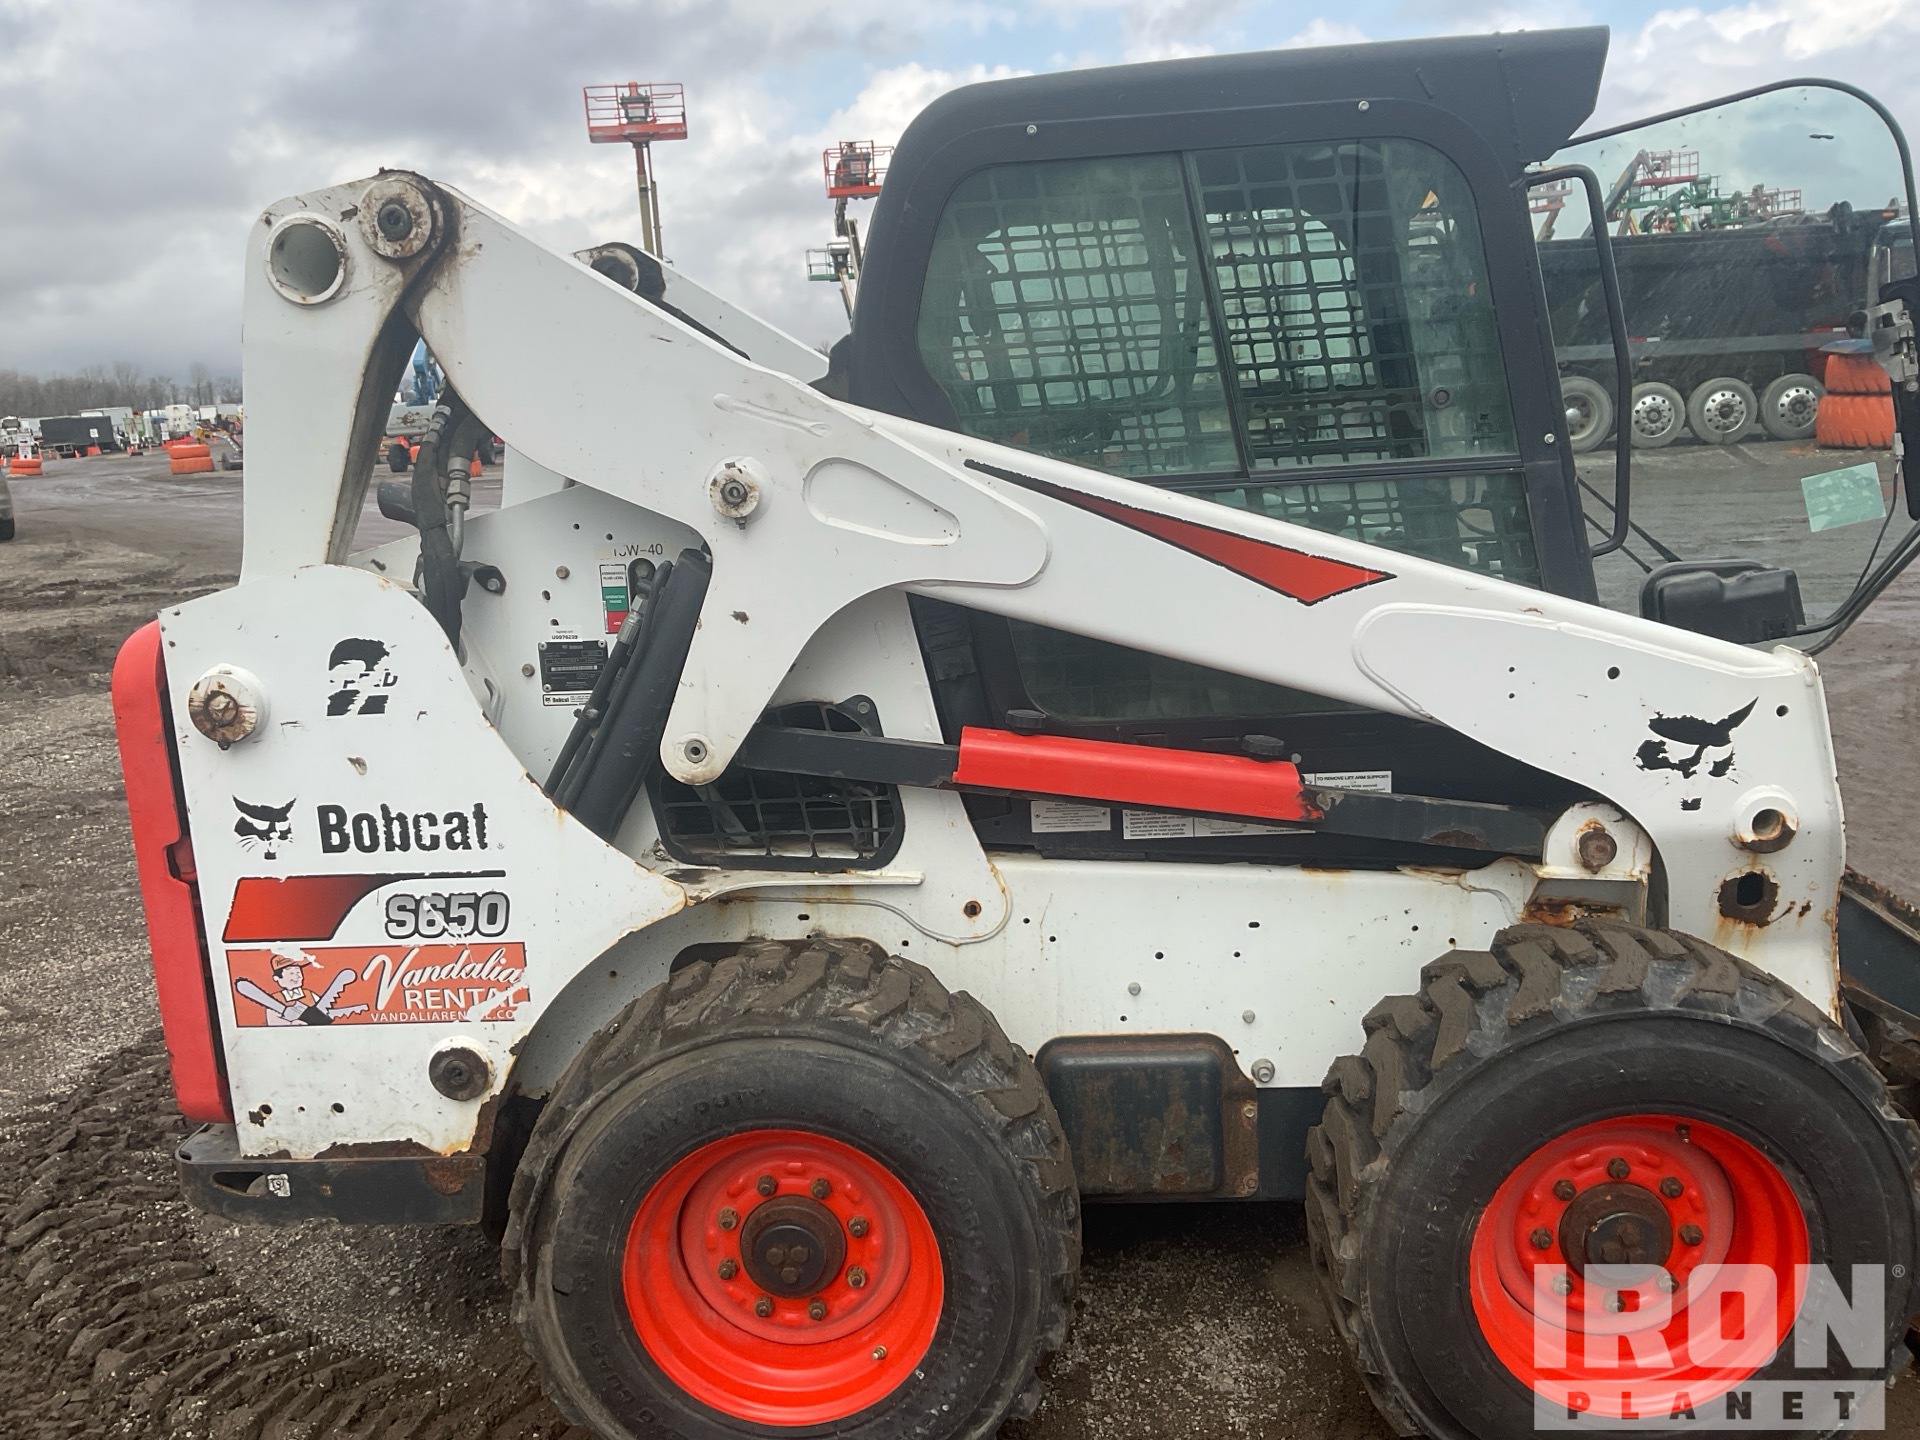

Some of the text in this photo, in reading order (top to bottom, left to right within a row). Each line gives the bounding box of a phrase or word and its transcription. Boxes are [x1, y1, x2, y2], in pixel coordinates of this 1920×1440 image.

[317, 802, 489, 853] Bobcat
[385, 891, 510, 938] S650
[361, 947, 523, 1011] Vandalia
